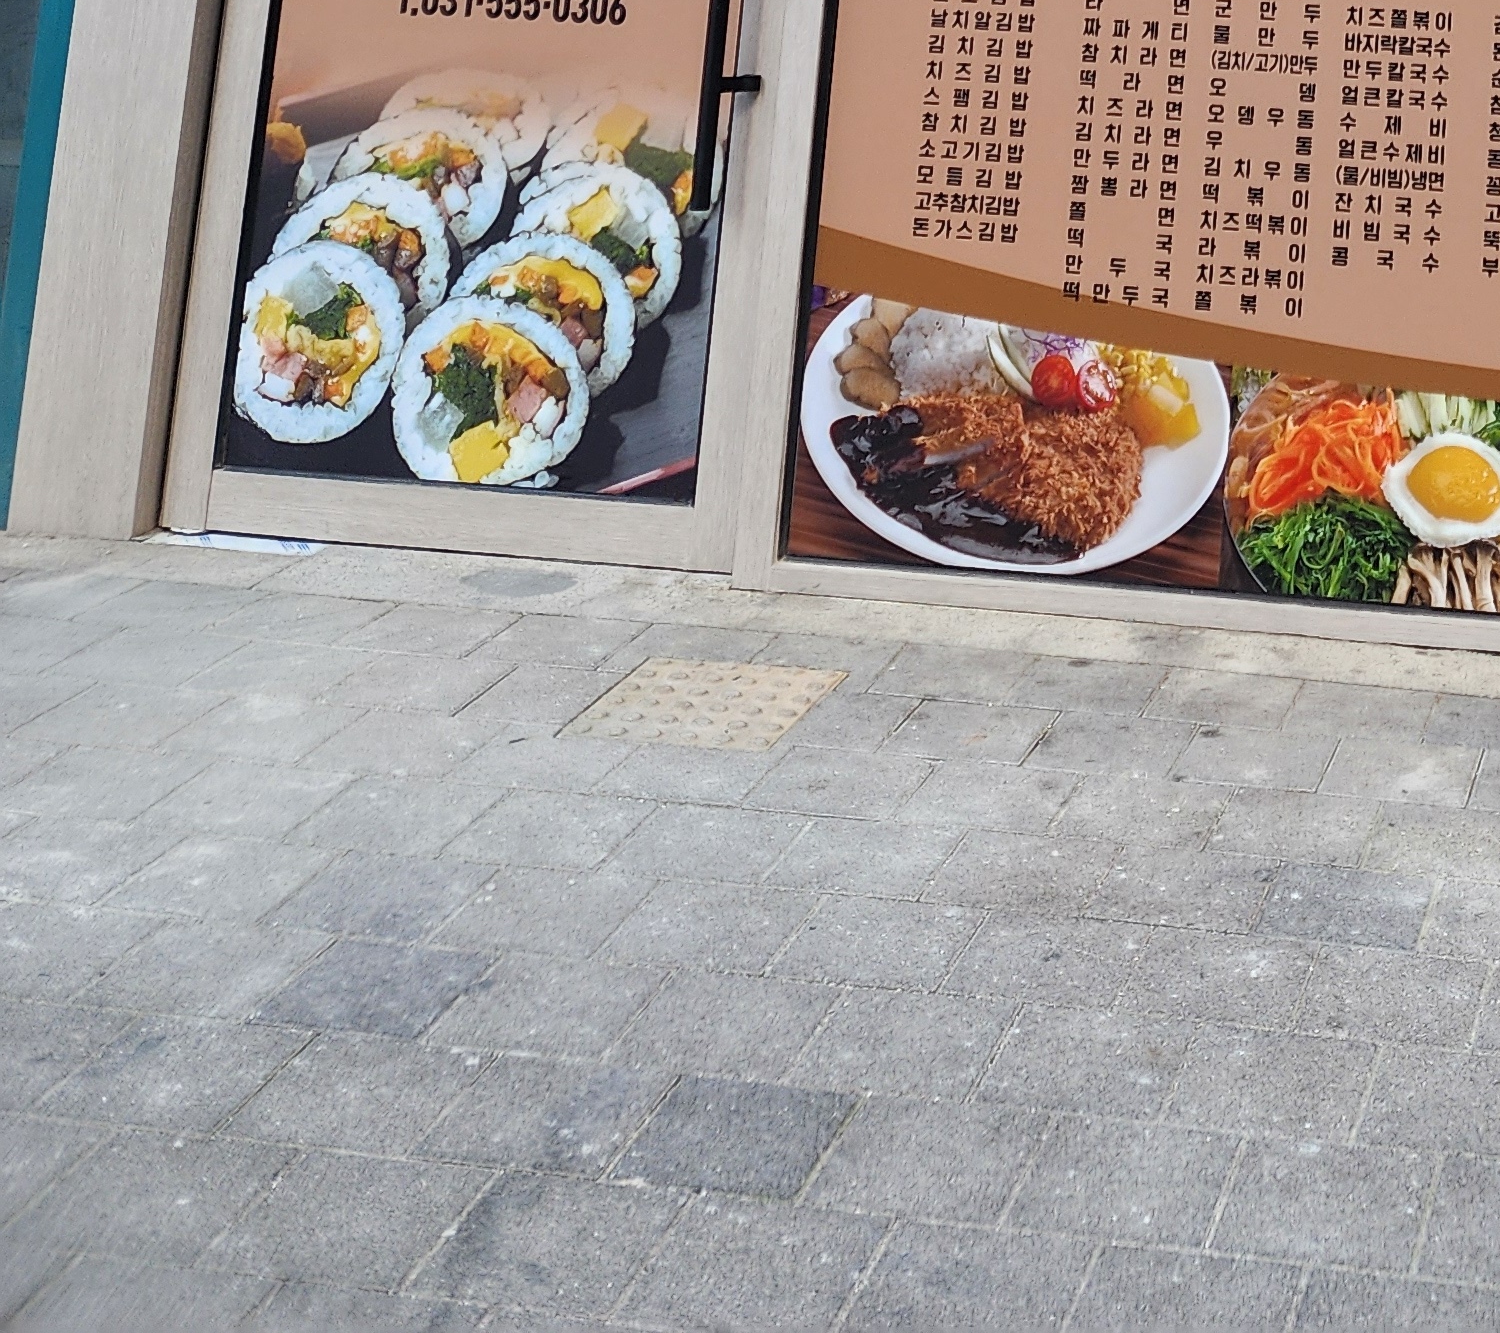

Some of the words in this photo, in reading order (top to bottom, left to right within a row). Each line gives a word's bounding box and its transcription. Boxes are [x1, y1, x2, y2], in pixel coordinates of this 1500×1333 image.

[931, 8, 1035, 33] 날치알김밥
[1215, 0, 1320, 23] 군만두
[1346, 6, 1452, 32] 치즈쫄볶이
[1083, 17, 1188, 42] 짜파게티
[1214, 25, 1318, 50] 물만두
[929, 35, 1033, 59] 김치김밥
[1082, 43, 1186, 68] 참치라면
[1345, 33, 1450, 58] 바지락칼국수
[926, 60, 1031, 85] 치즈김밥
[1080, 70, 1184, 94] 떡라면
[1343, 59, 1449, 85] 만두칼국수
[923, 87, 1029, 111] 스팸김밥
[1077, 95, 1182, 121] 치즈라면
[1342, 86, 1447, 112] 얼큰칼국수
[922, 112, 1027, 137] 참치김밥
[1207, 104, 1314, 129] 오뎅우동
[1340, 112, 1446, 138] 수제비
[1076, 122, 1180, 147] 김치라면
[919, 139, 1024, 163] 소고기김밥
[1074, 149, 1178, 174] 만두라면
[1339, 139, 1444, 165] 얼큰수제비
[1204, 157, 1310, 182] 김치우동
[1071, 175, 1176, 201] 짬뽕라면
[1203, 184, 1309, 210] 떡볶이
[914, 192, 1020, 216] 고추참치김밥
[1335, 193, 1442, 219] 잔치국수
[913, 217, 1018, 243] 돈가스김밥
[1200, 210, 1307, 237] 치즈떡볶이
[1333, 219, 1440, 246] 비빔국수
[1198, 237, 1305, 263] 라볶이
[1332, 247, 1439, 273] 콩국수
[1066, 255, 1170, 281] 만두국
[1196, 264, 1304, 291] 치즈라볶이
[1063, 281, 1168, 308] 떡만두국
[1195, 291, 1302, 318] 쫄볶이
